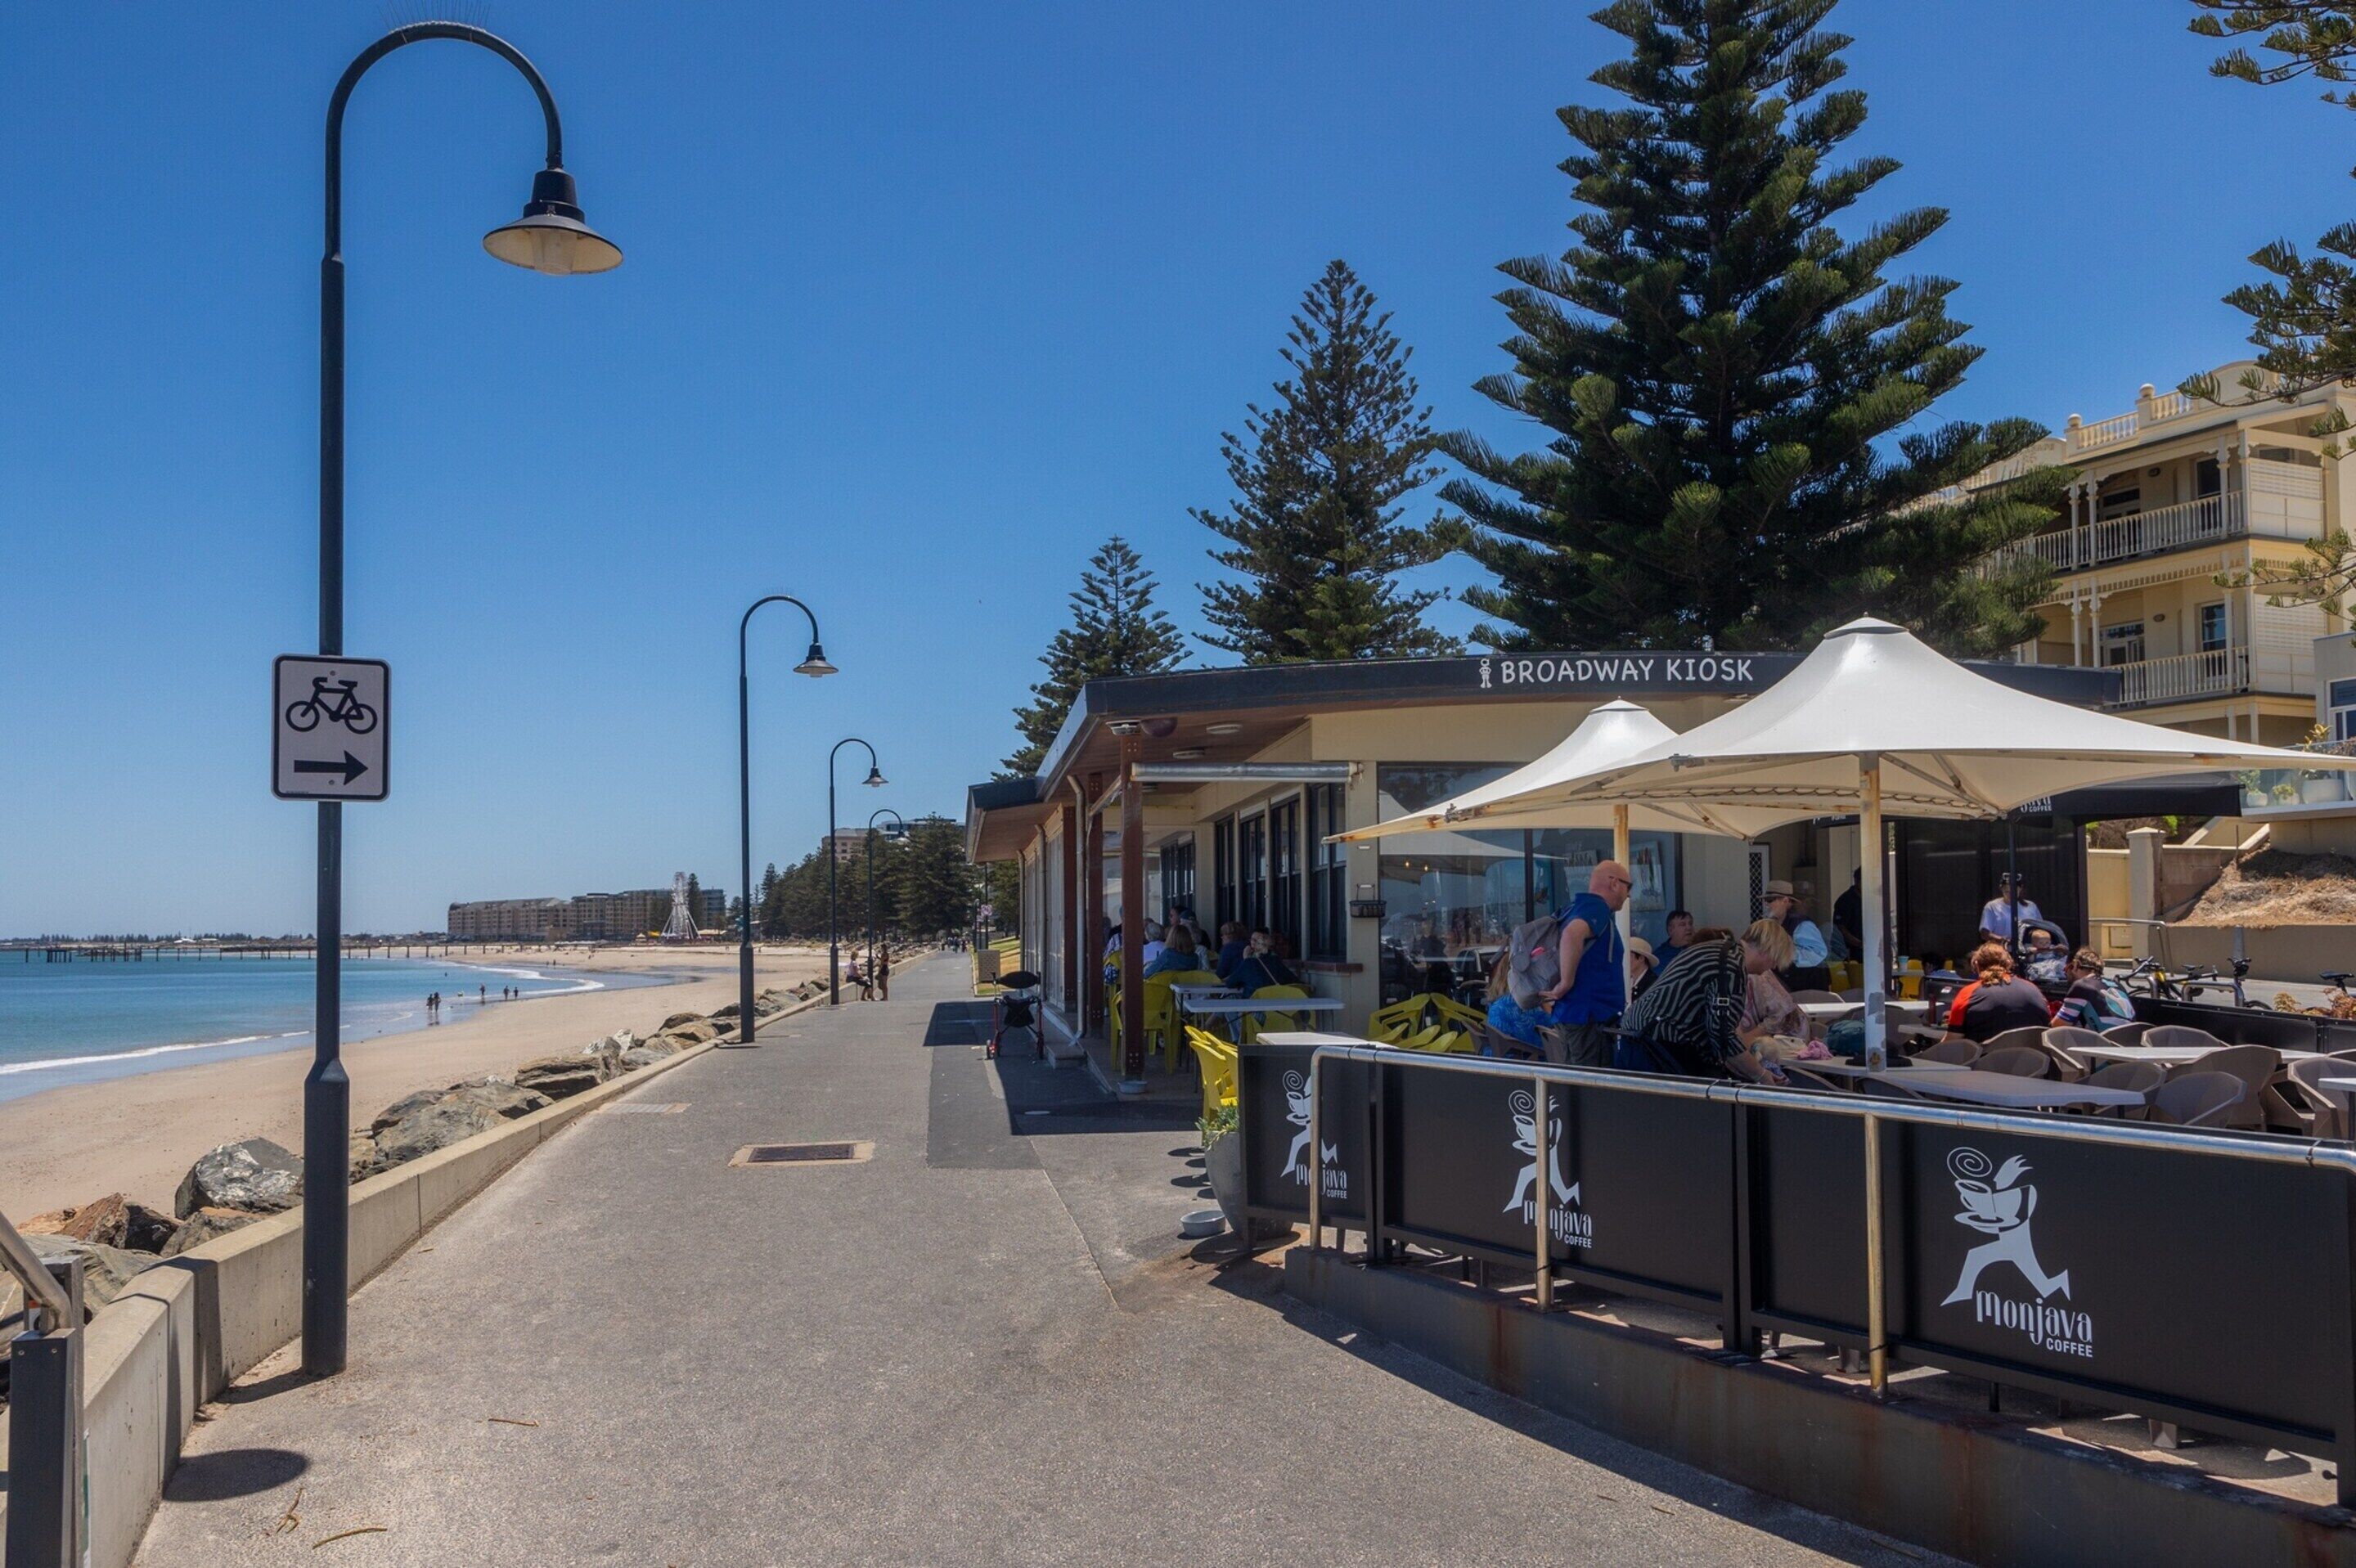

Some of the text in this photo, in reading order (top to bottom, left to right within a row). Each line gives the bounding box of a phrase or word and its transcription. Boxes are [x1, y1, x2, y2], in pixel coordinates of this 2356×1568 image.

[1500, 658, 1754, 684] BROADWAY KIOSK
[1296, 1163, 1347, 1195] mjava
[1327, 1188, 1347, 1199] COFFEE
[1524, 1200, 1592, 1240] mnjava
[1563, 1233, 1592, 1248] COFFEE
[1976, 1289, 2093, 1345] monjava
[2046, 1337, 2093, 1358] COFFEE
